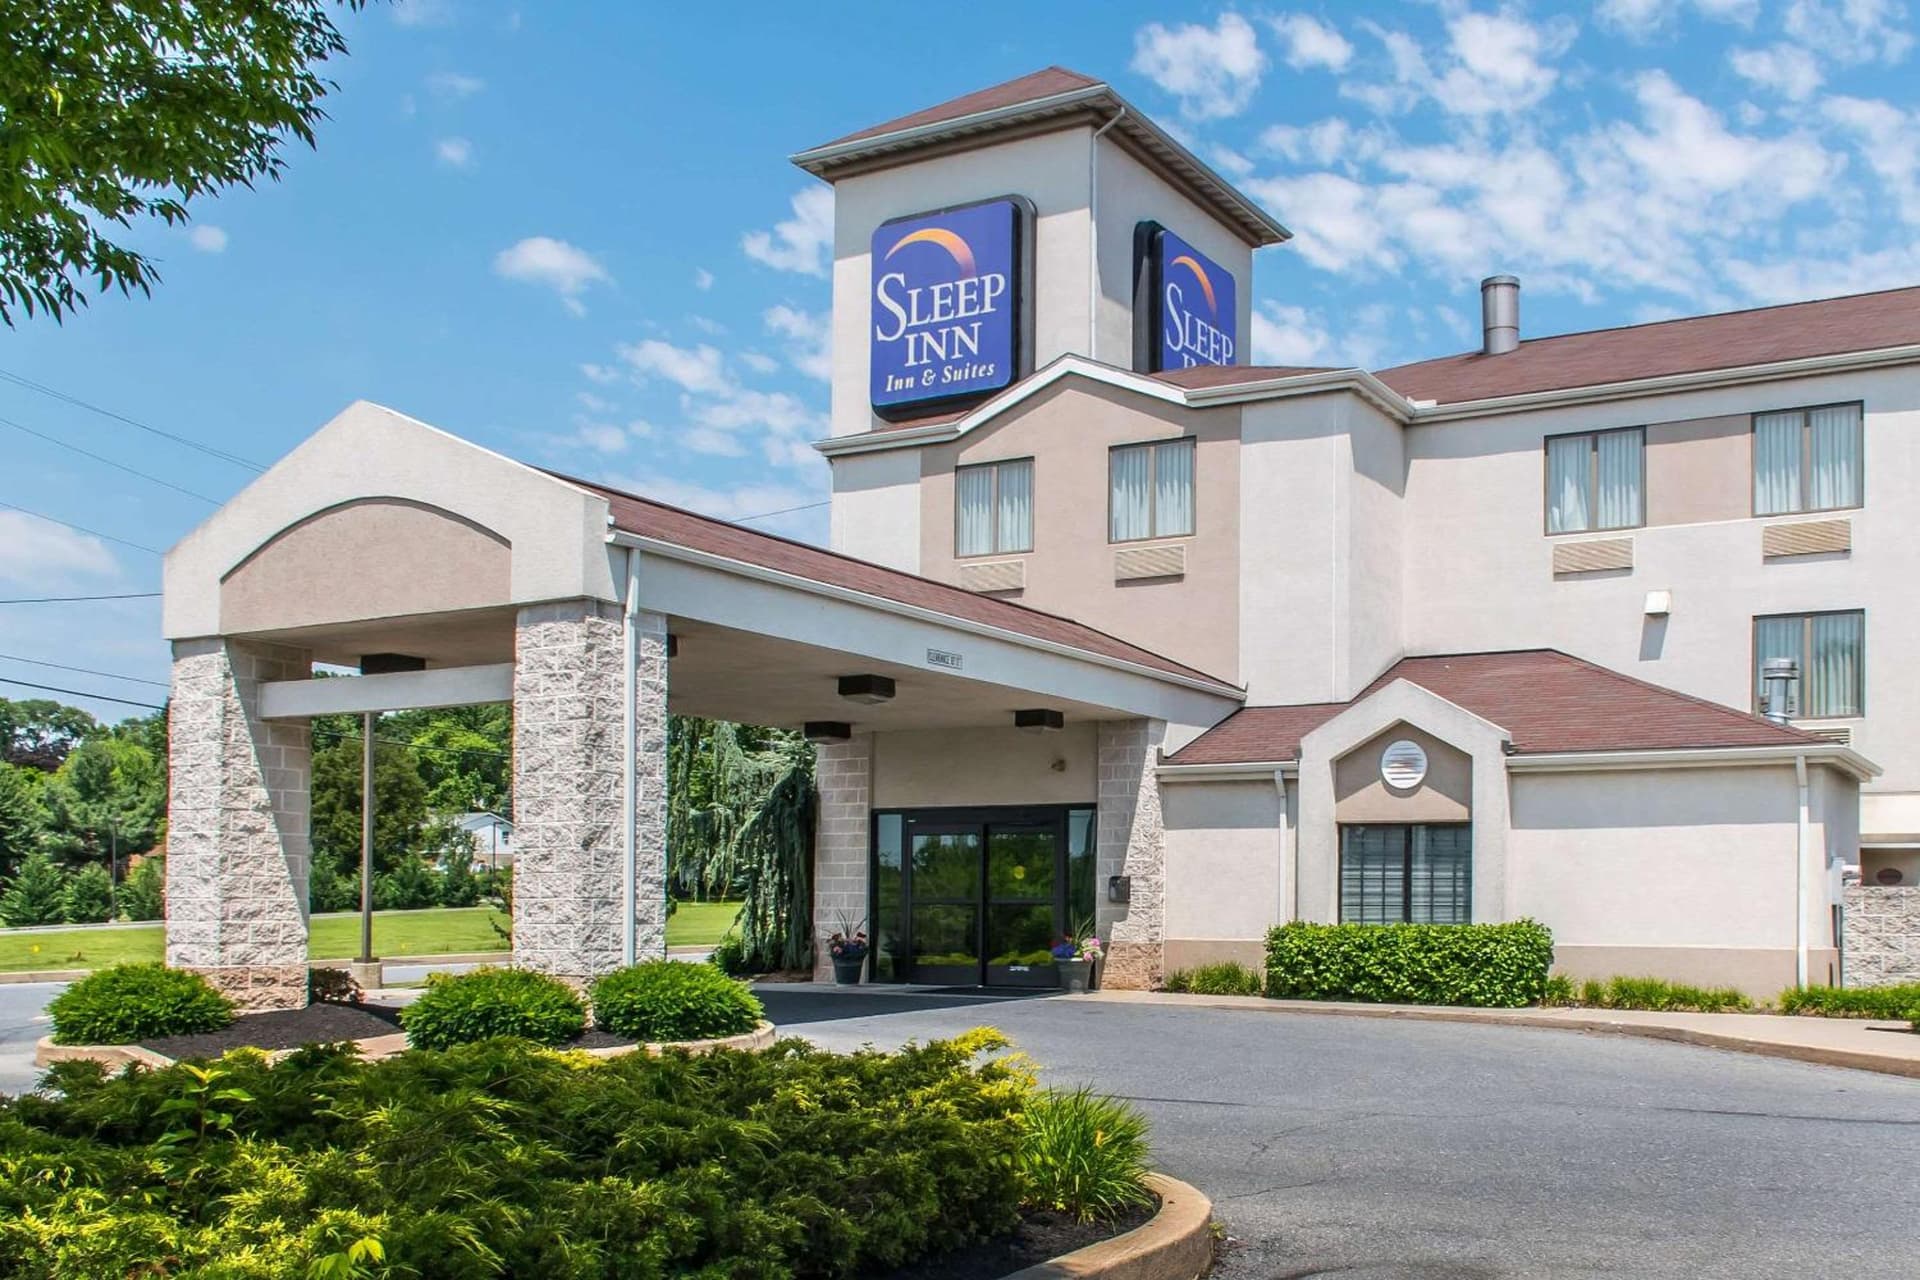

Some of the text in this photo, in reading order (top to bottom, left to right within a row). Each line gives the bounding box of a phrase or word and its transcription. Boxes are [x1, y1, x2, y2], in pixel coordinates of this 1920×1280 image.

[876, 273, 1006, 342] SLEEP
[1166, 282, 1233, 366] SLEEP
[904, 322, 982, 367] INN
[886, 362, 995, 392] Inn & Suites
